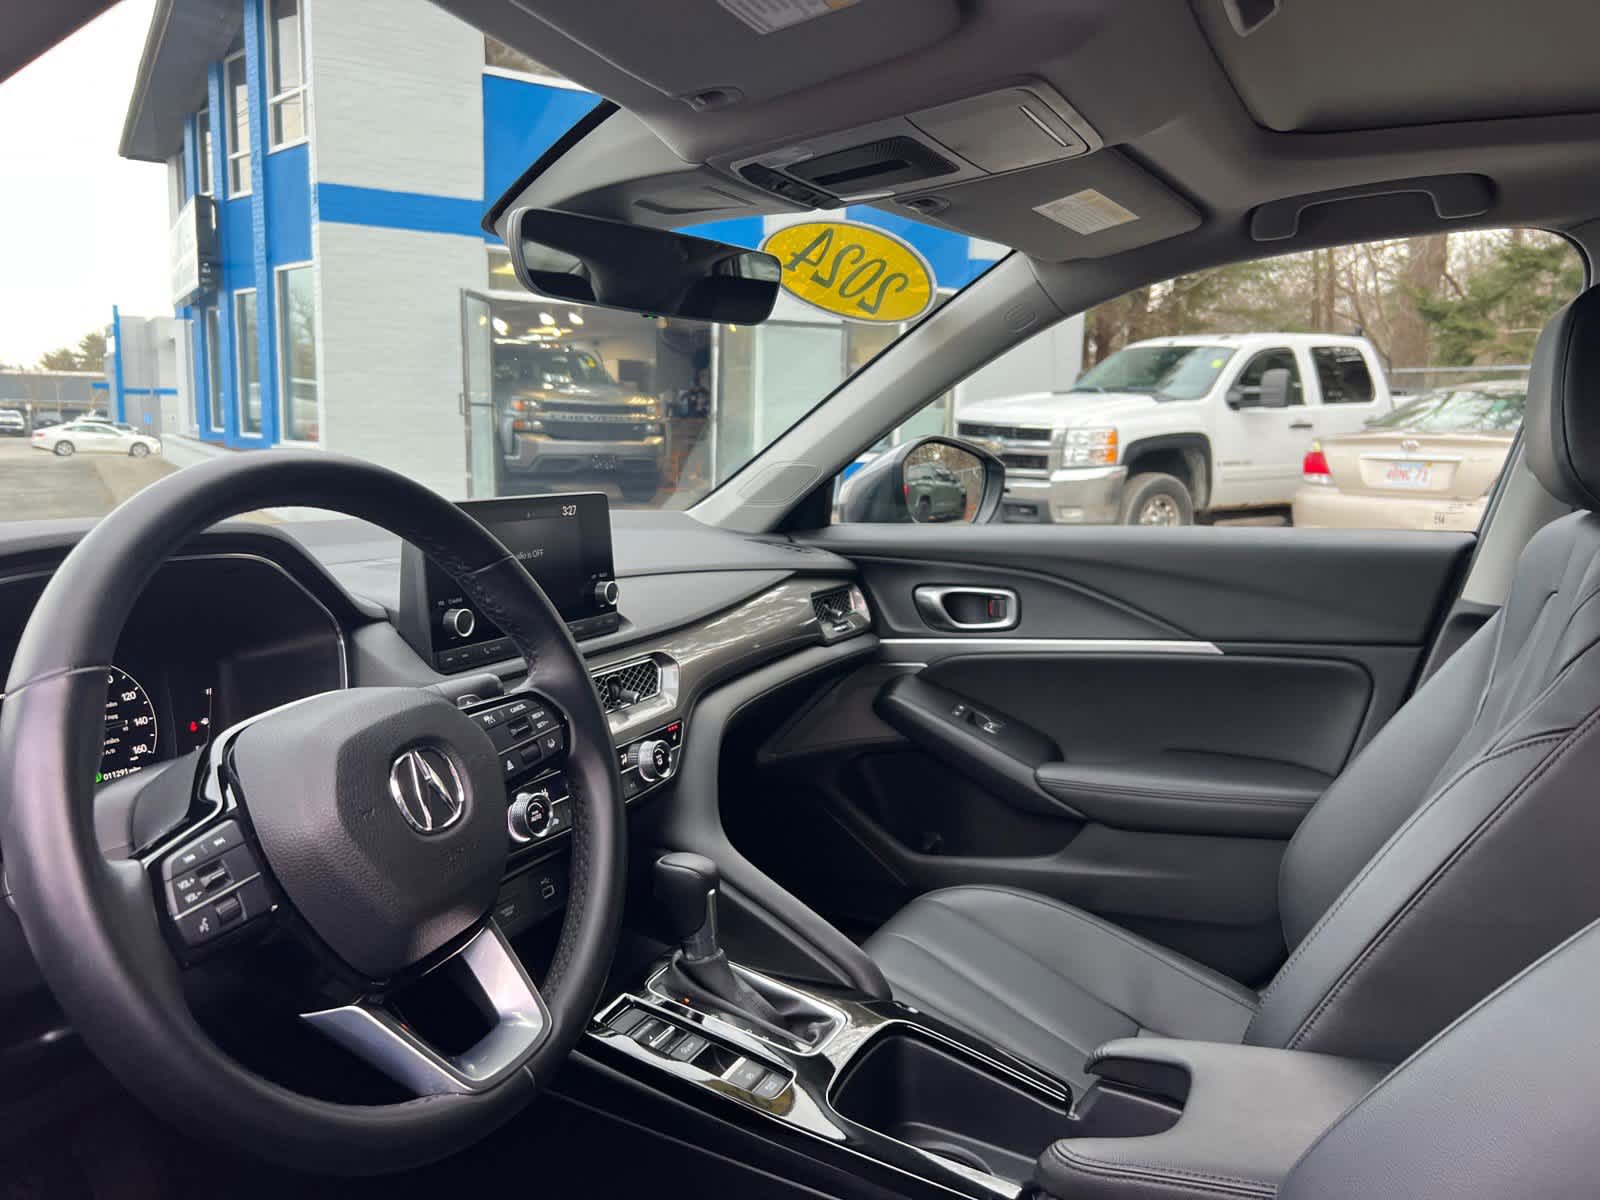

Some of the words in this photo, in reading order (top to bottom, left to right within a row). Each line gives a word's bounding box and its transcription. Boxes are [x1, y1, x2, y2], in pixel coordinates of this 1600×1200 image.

[532, 548, 545, 558] OFF
[121, 690, 136, 701] 120
[133, 715, 149, 726] 140
[132, 743, 148, 755] 160
[102, 768, 128, 780] 011291
